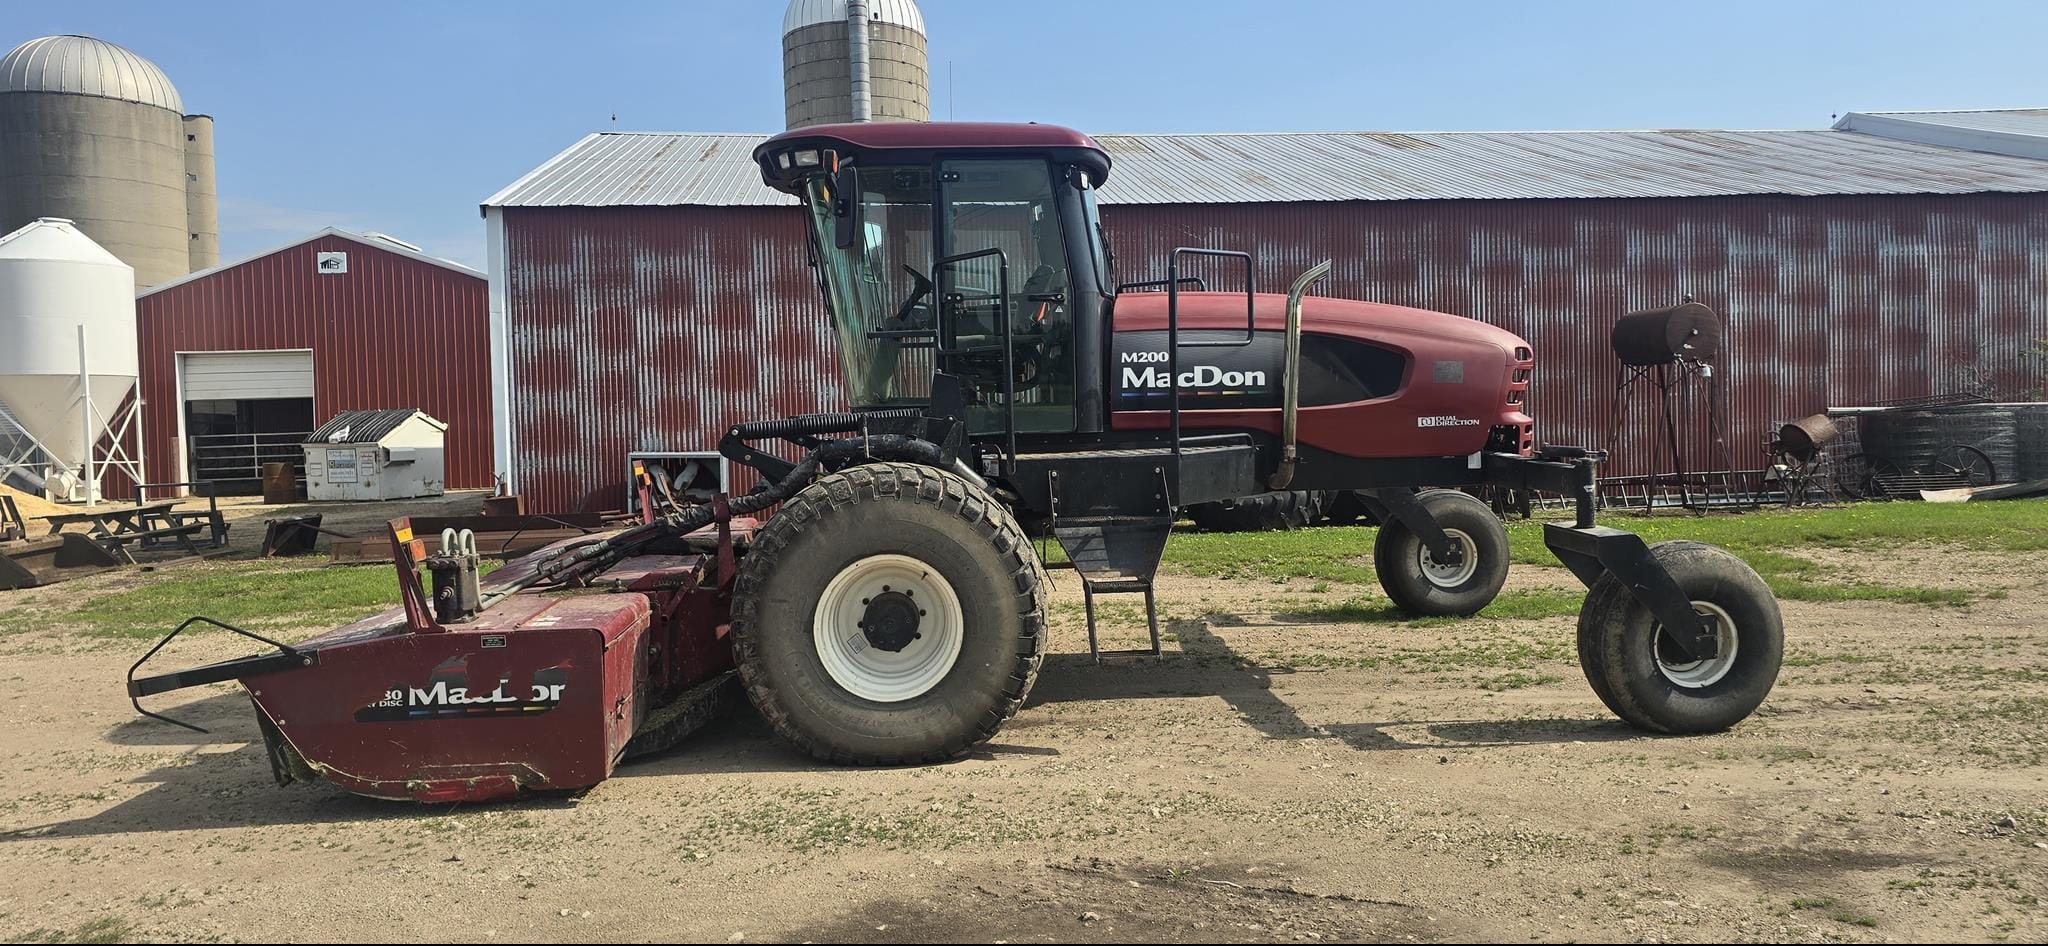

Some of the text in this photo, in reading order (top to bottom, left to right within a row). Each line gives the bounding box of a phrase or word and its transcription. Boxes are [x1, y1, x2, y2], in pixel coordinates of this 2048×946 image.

[1121, 352, 1169, 363] M200
[1122, 365, 1266, 389] MacDon
[379, 700, 403, 708] DISC
